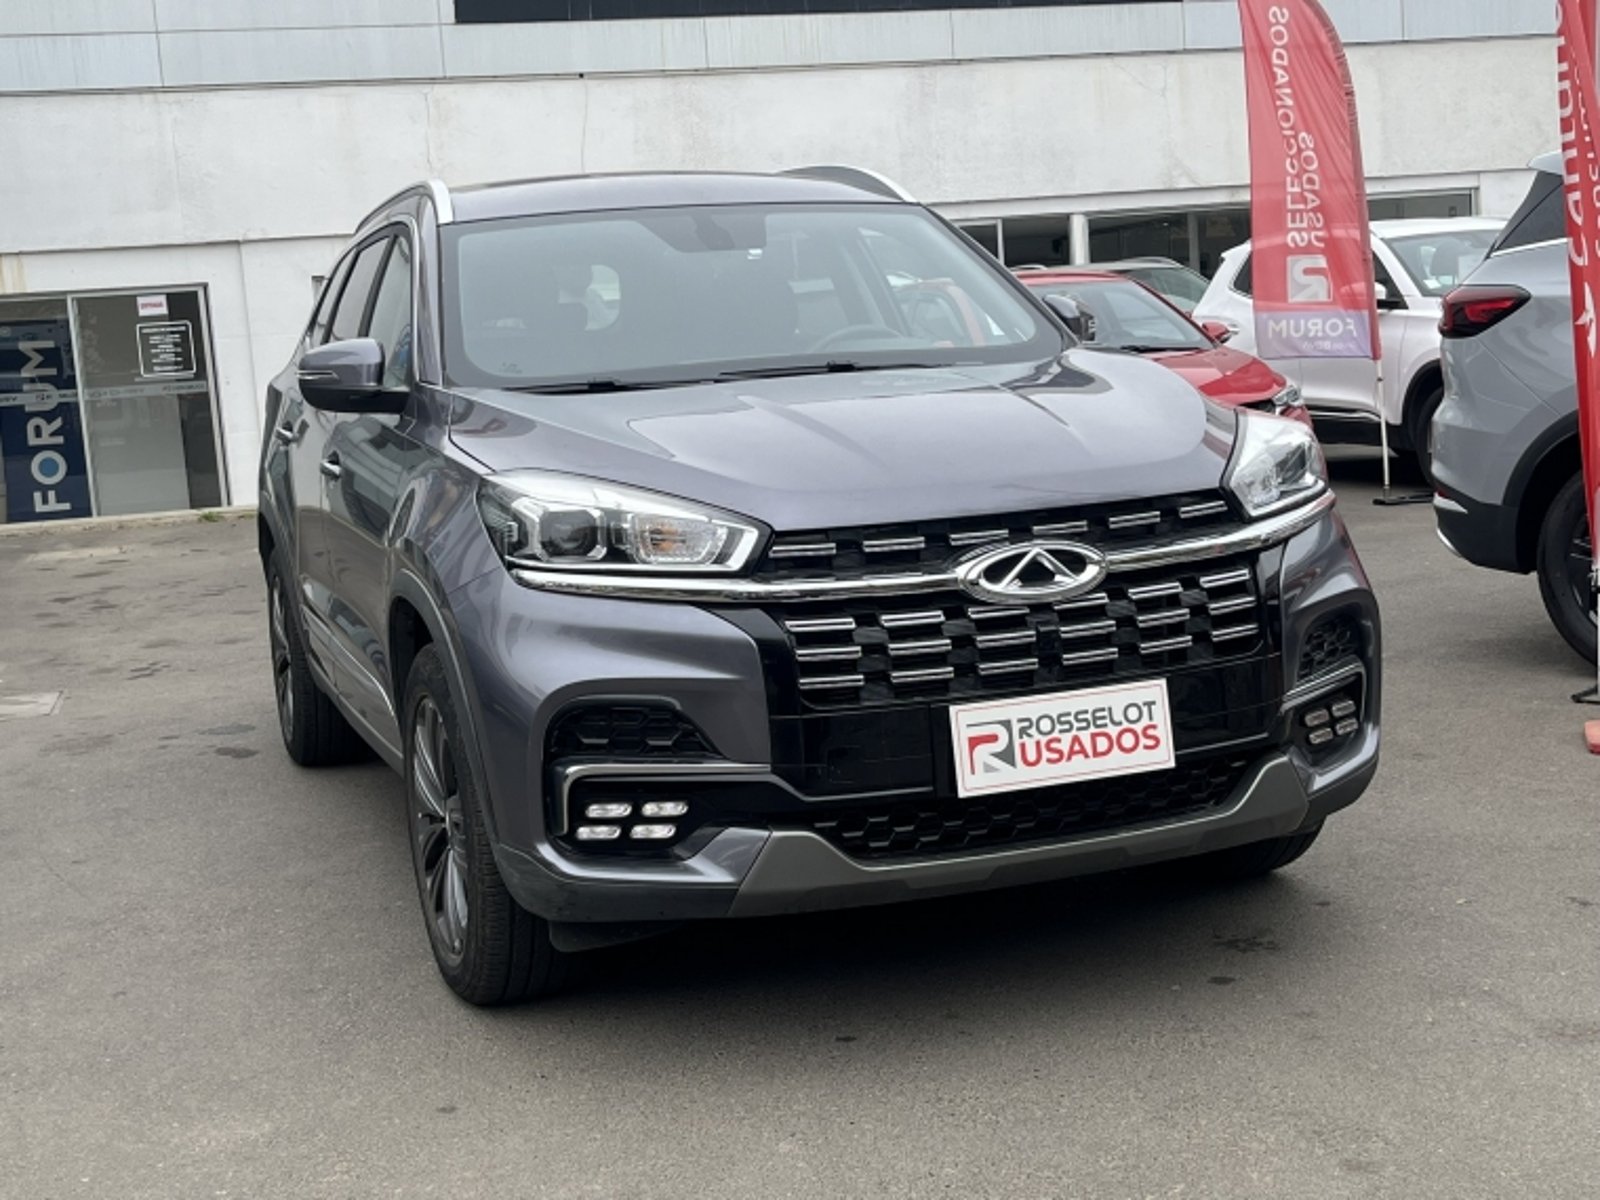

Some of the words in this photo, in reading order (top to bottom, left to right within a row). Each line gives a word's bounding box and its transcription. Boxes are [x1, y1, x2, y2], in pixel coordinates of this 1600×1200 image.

[18, 340, 72, 512] FORUM
[1017, 701, 1157, 739] ROSSELOT
[1019, 724, 1161, 767] USADOS
